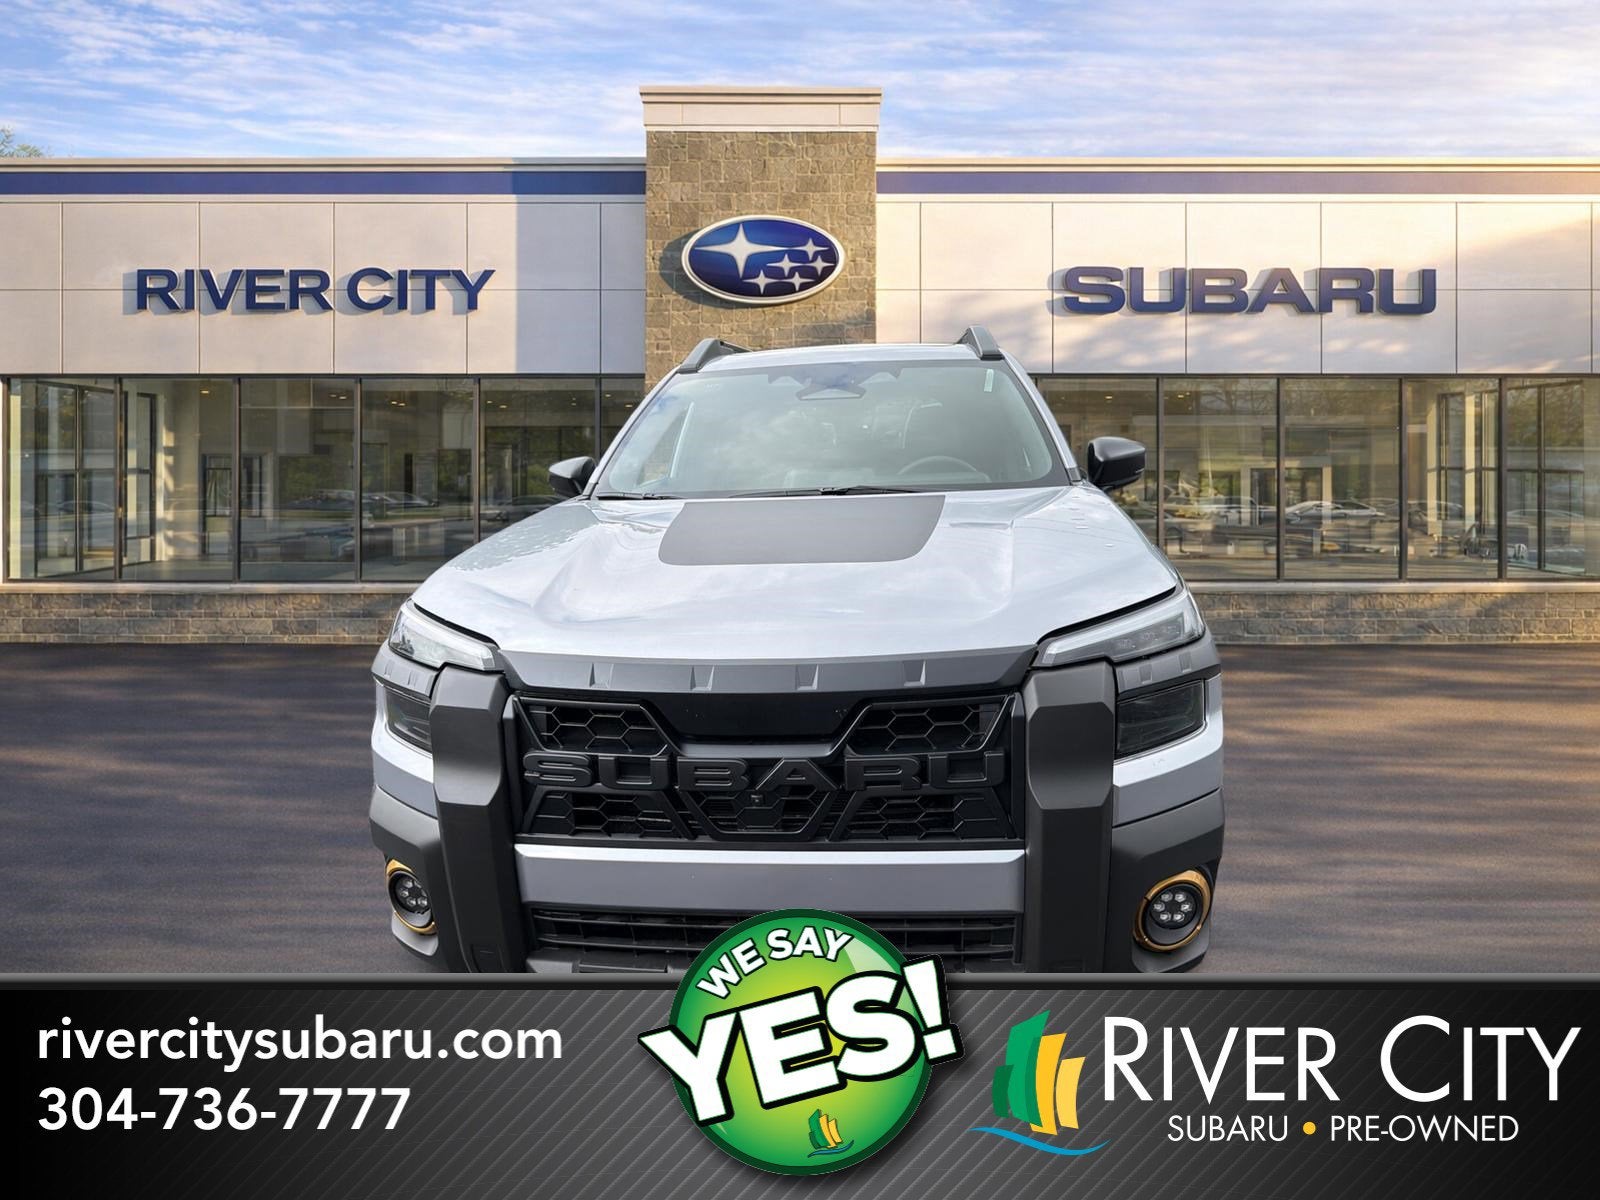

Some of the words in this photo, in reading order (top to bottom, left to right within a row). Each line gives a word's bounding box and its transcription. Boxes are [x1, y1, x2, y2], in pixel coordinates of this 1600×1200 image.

[136, 268, 332, 311] RIVER
[347, 267, 495, 311] CITY
[1063, 266, 1437, 315] SUBARU
[522, 750, 1005, 791] SUBARU
